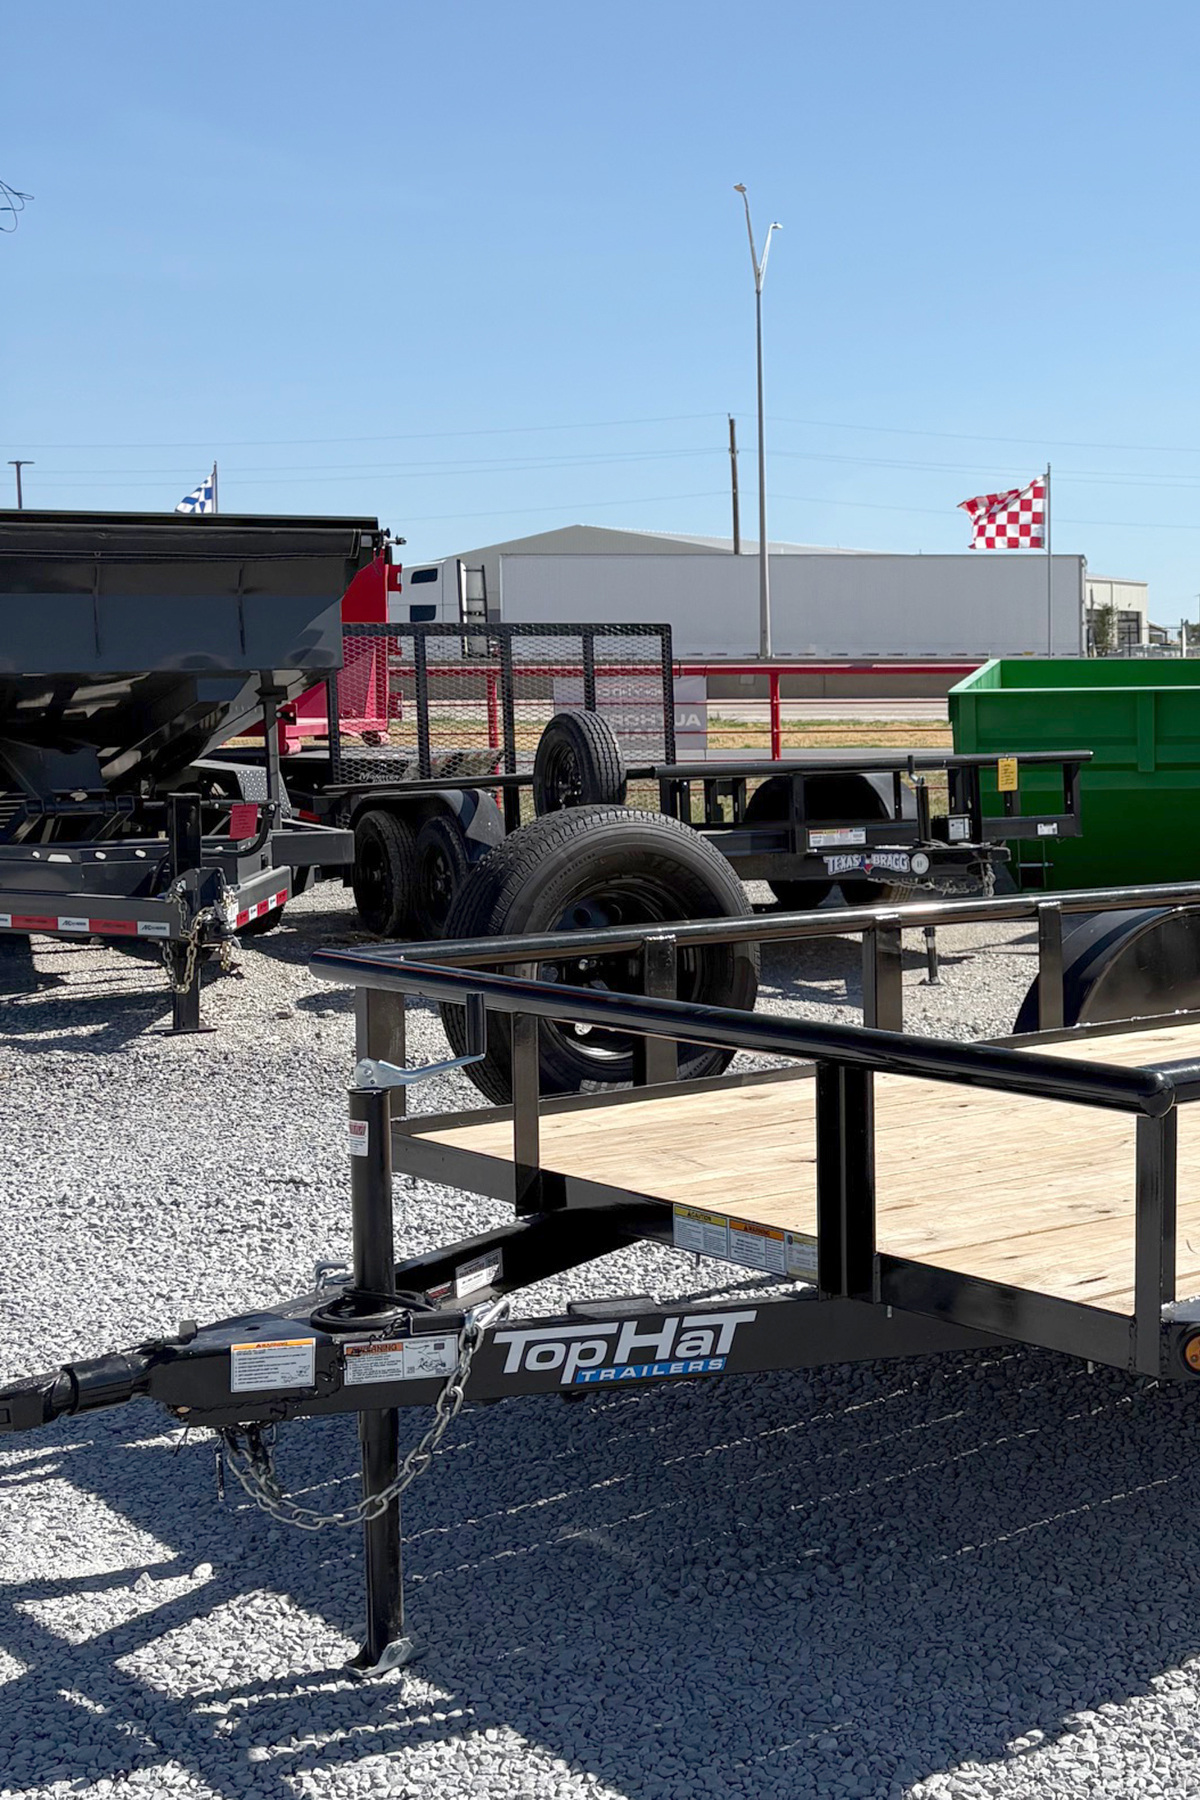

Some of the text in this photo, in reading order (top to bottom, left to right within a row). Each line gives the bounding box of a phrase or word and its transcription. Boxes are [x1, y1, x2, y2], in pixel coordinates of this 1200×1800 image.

[823, 855, 860, 875] TEXAS
[871, 853, 910, 873] BRAGG
[691, 1210, 712, 1222] CAUTION
[581, 1358, 723, 1382] TRAILERS
